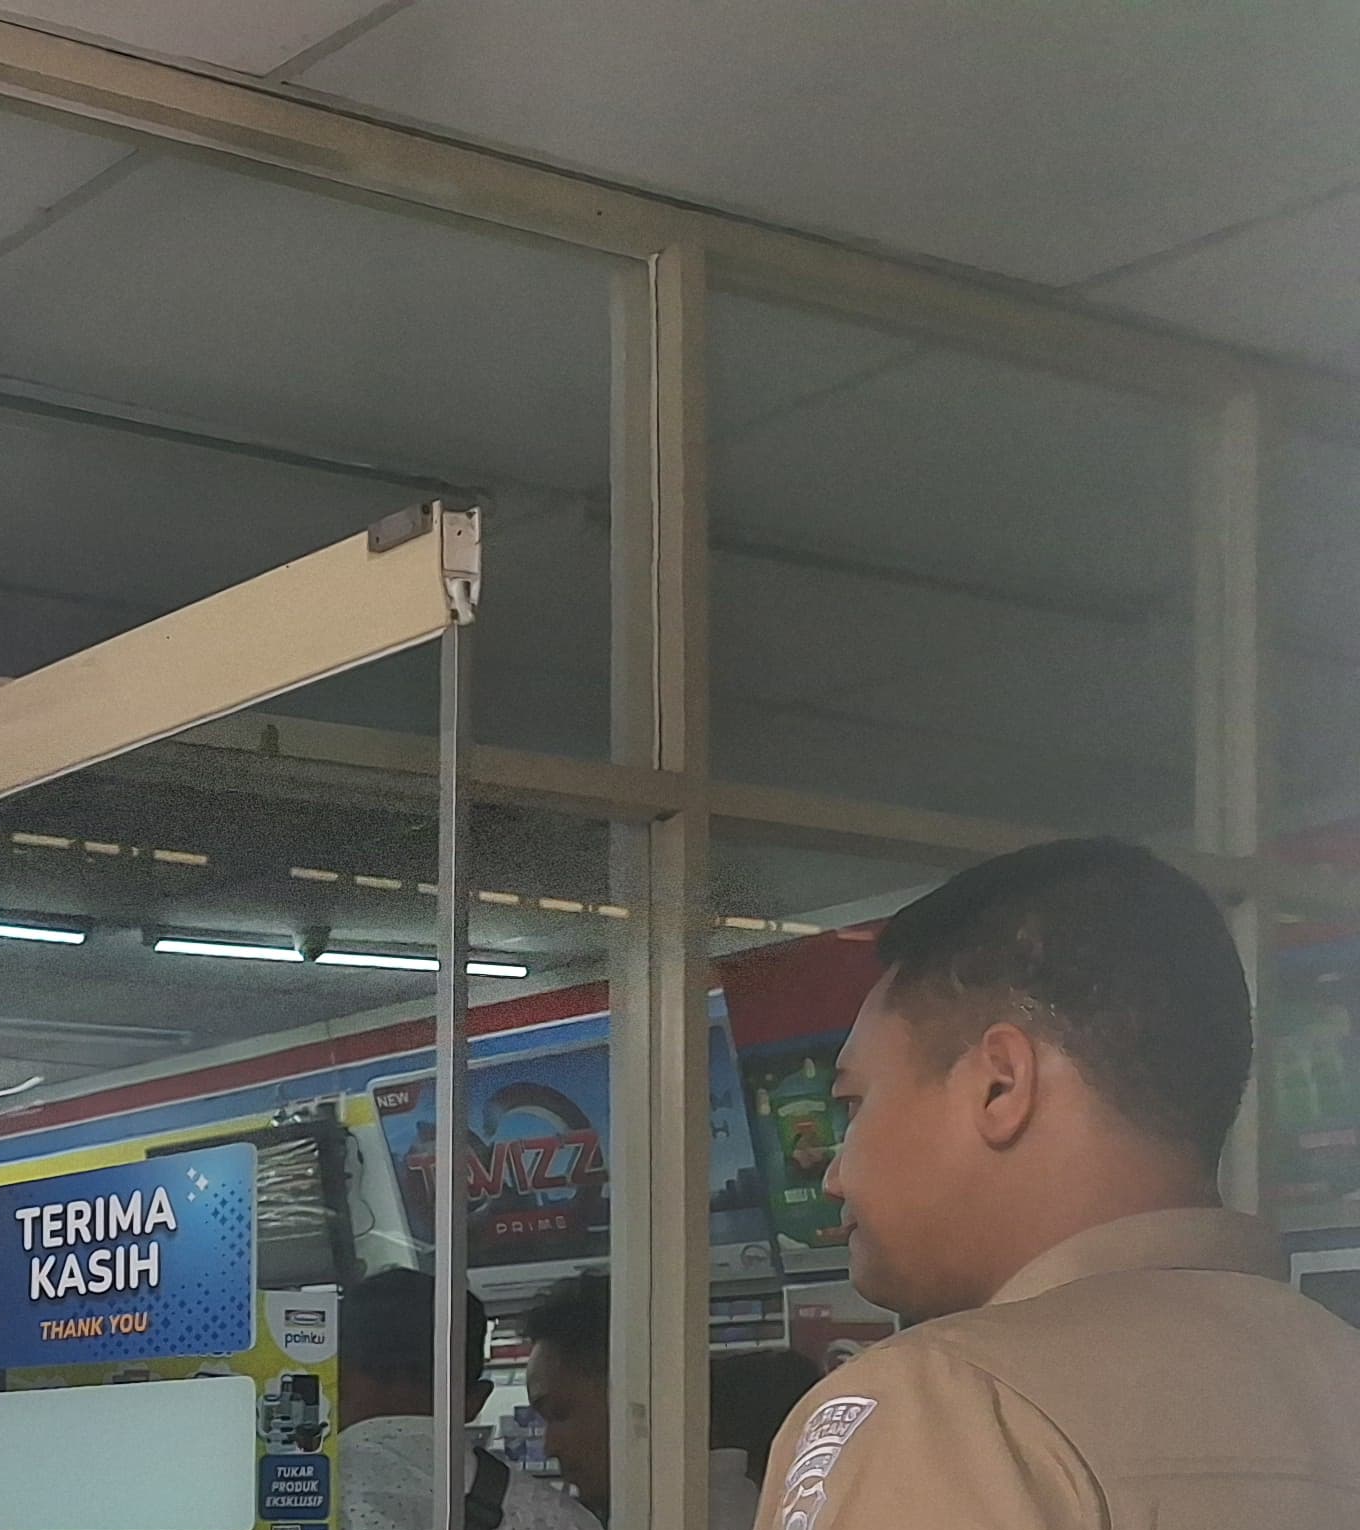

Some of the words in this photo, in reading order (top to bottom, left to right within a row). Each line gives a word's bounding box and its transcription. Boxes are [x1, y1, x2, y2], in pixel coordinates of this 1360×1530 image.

[376, 1092, 410, 1109] NEW
[15, 1186, 177, 1251] TERIMA
[496, 1215, 567, 1235] PRIME
[31, 1241, 160, 1301] KASIH
[40, 1316, 104, 1341] THANK
[109, 1312, 148, 1334] YOU
[276, 1466, 314, 1478] TUKAR
[271, 1480, 319, 1493] PRODUK
[265, 1496, 324, 1508] EKSKLUSIF
